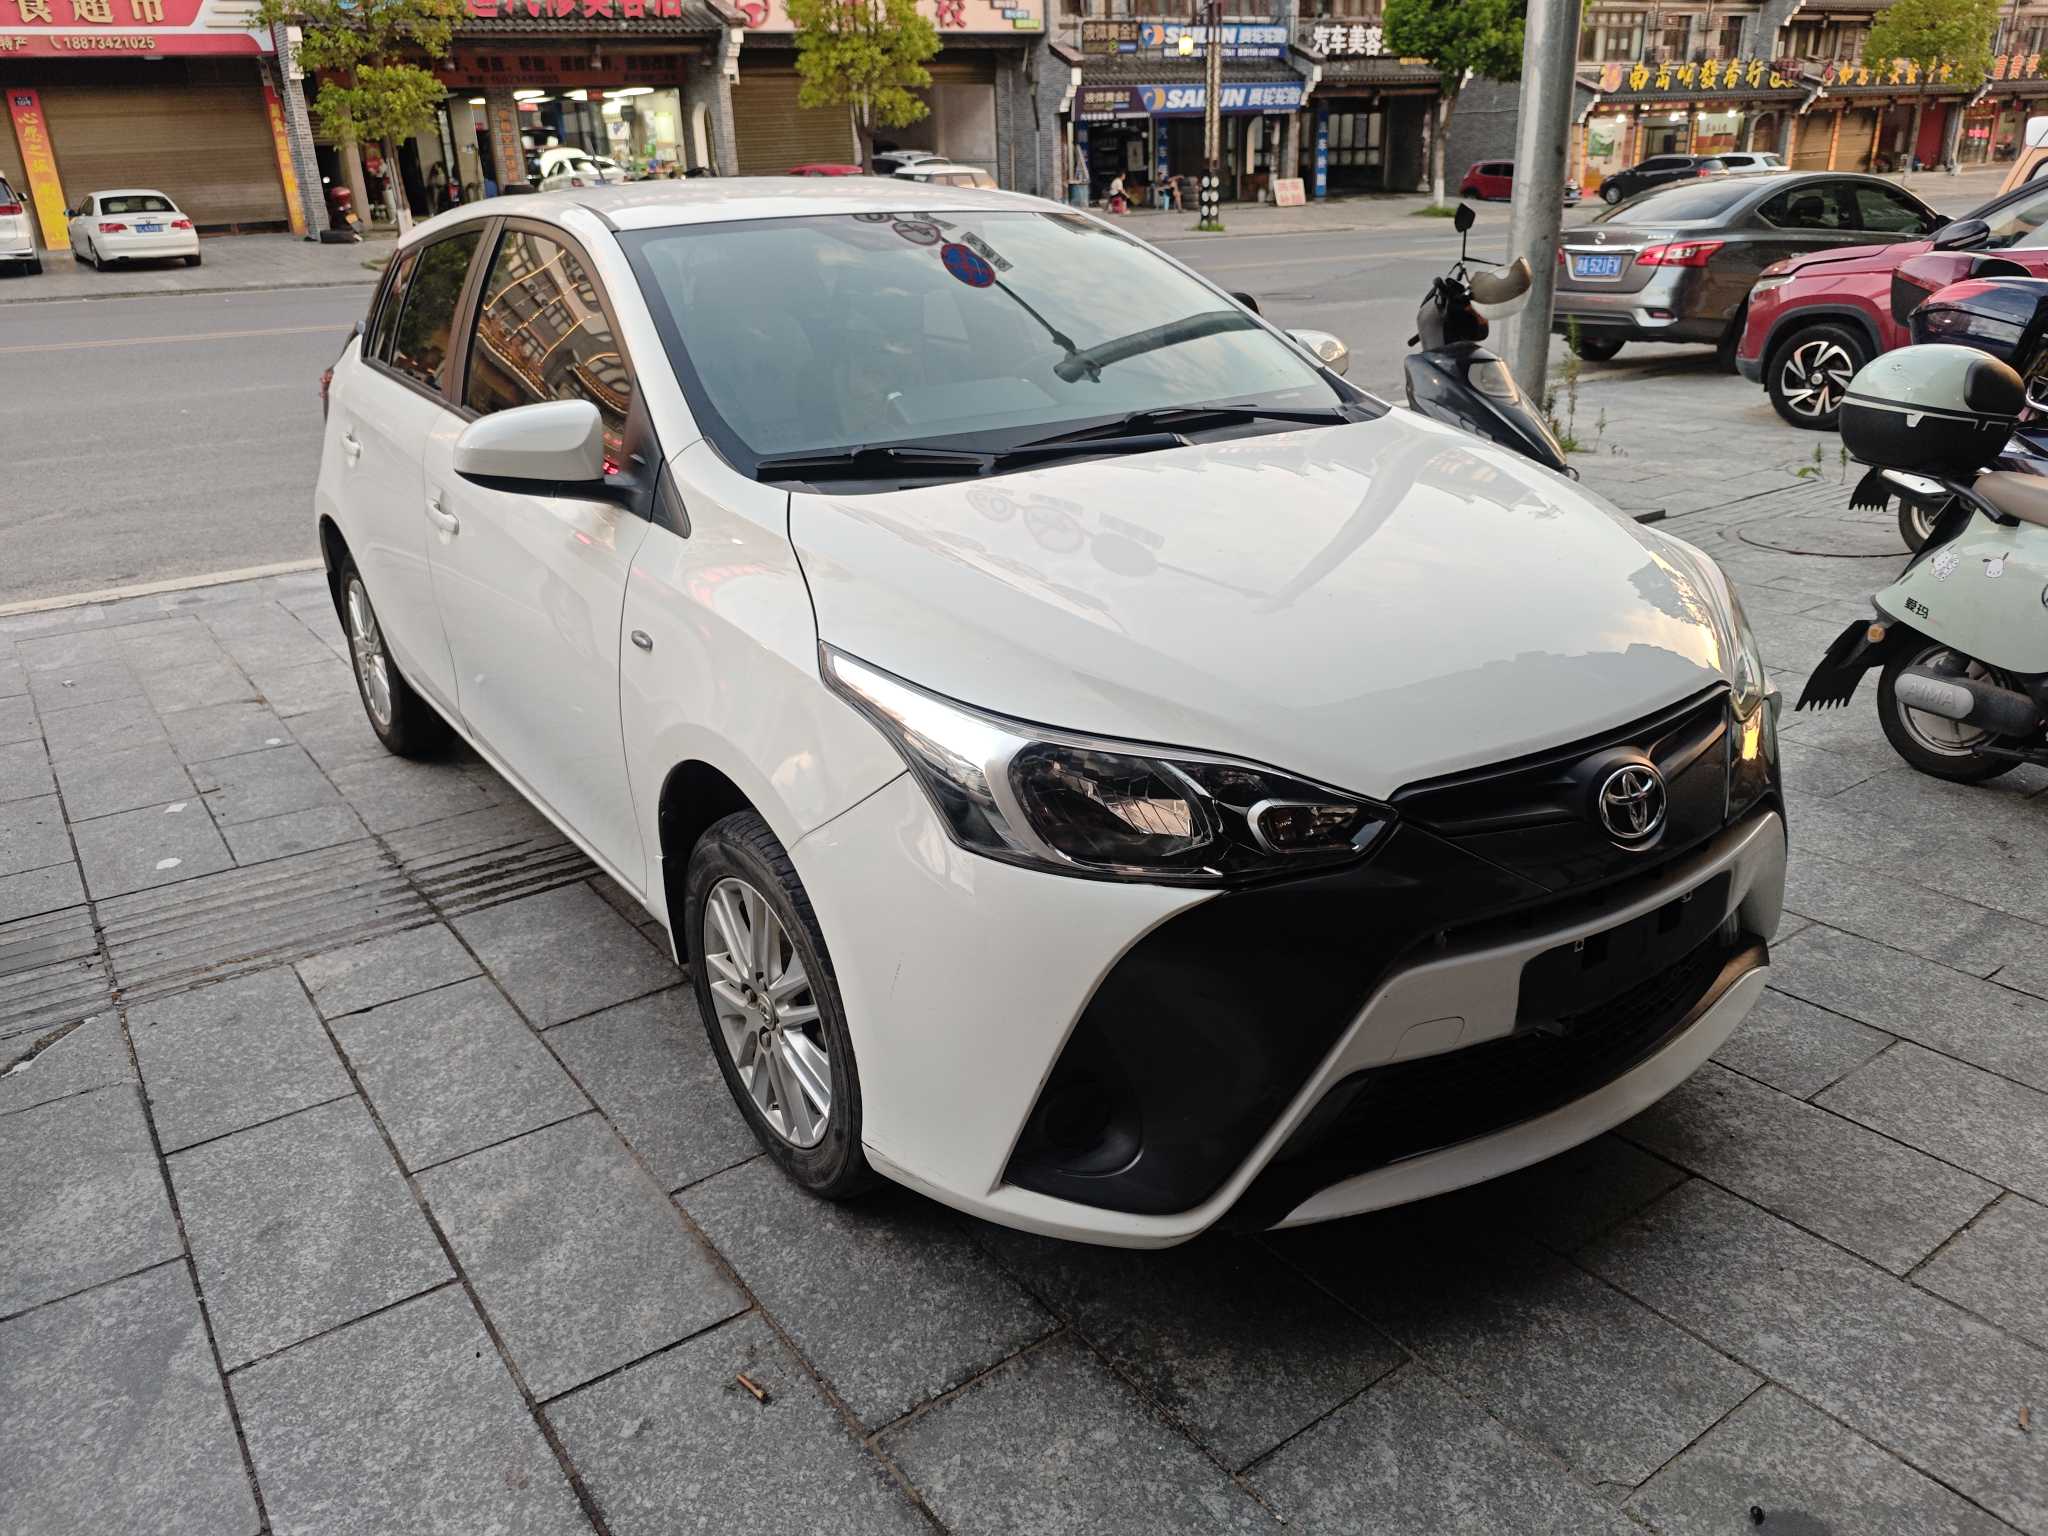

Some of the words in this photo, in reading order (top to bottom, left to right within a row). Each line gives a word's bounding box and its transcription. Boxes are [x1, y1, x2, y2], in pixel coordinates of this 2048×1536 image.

[63, 37, 156, 49] 18873421025
[1313, 25, 1391, 56] 汽车美容
[1904, 596, 1929, 619] 爱玛
